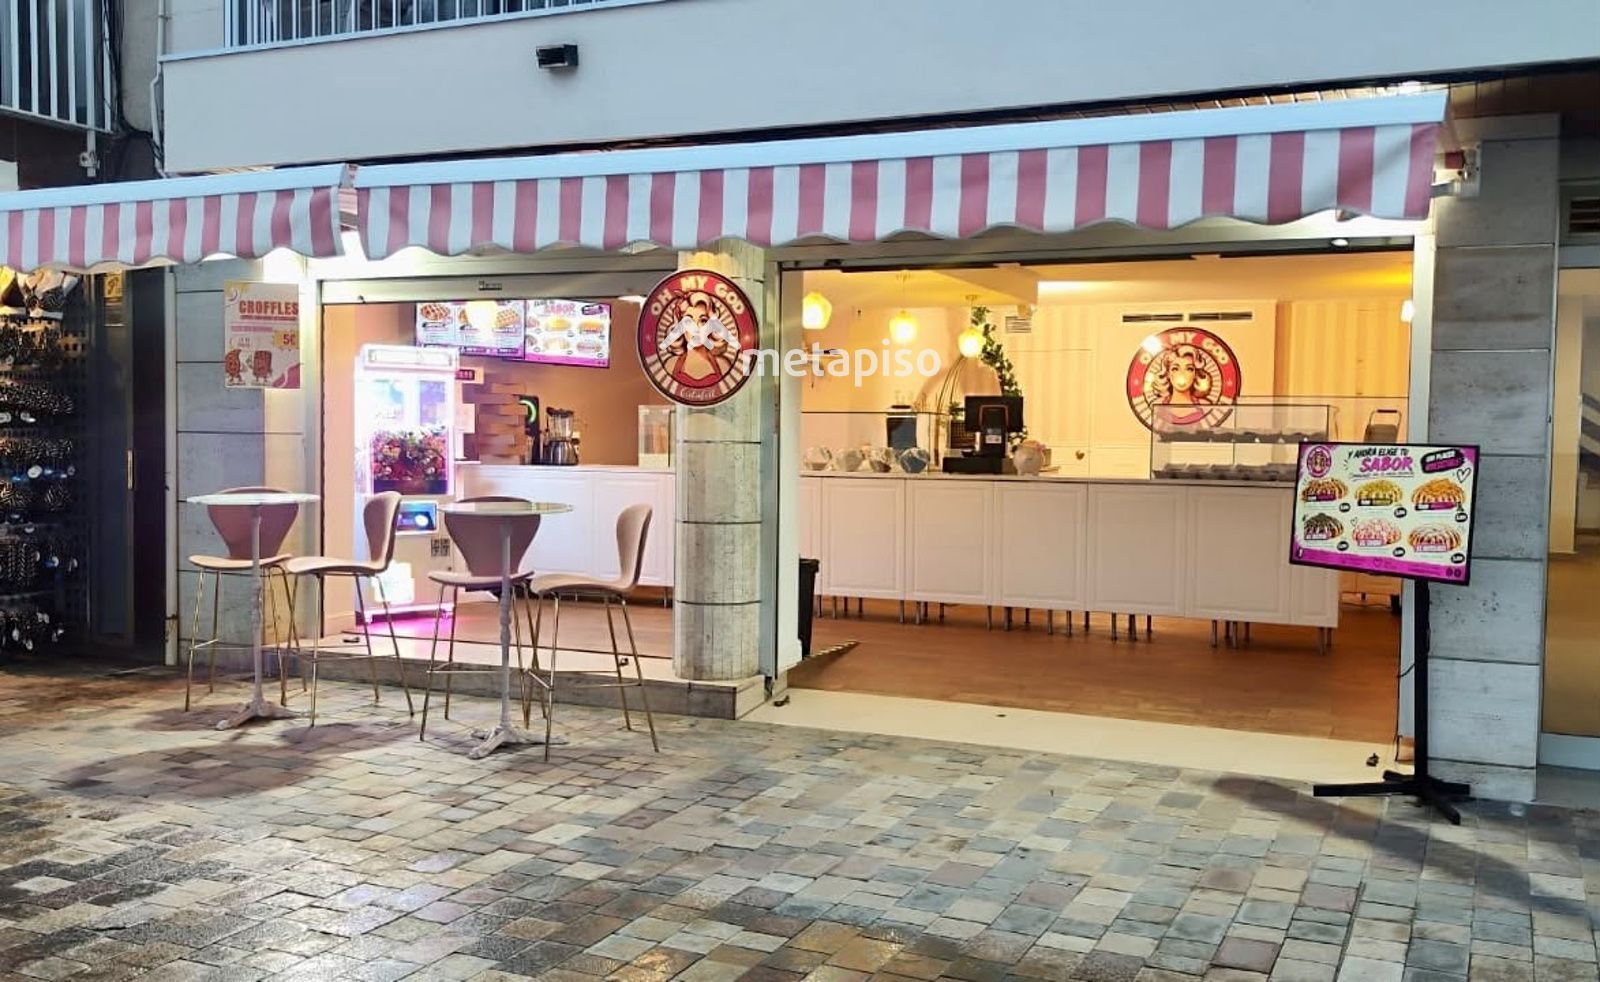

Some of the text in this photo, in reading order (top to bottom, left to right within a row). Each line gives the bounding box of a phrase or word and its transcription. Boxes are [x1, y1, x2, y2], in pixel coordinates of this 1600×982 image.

[651, 275, 746, 316] OH MY GOD
[239, 300, 299, 315] CROFFLES
[1202, 337, 1229, 365] GOD
[1353, 448, 1377, 459] AHORA
[1400, 448, 1410, 456] TU
[1359, 456, 1414, 473] SABOR
